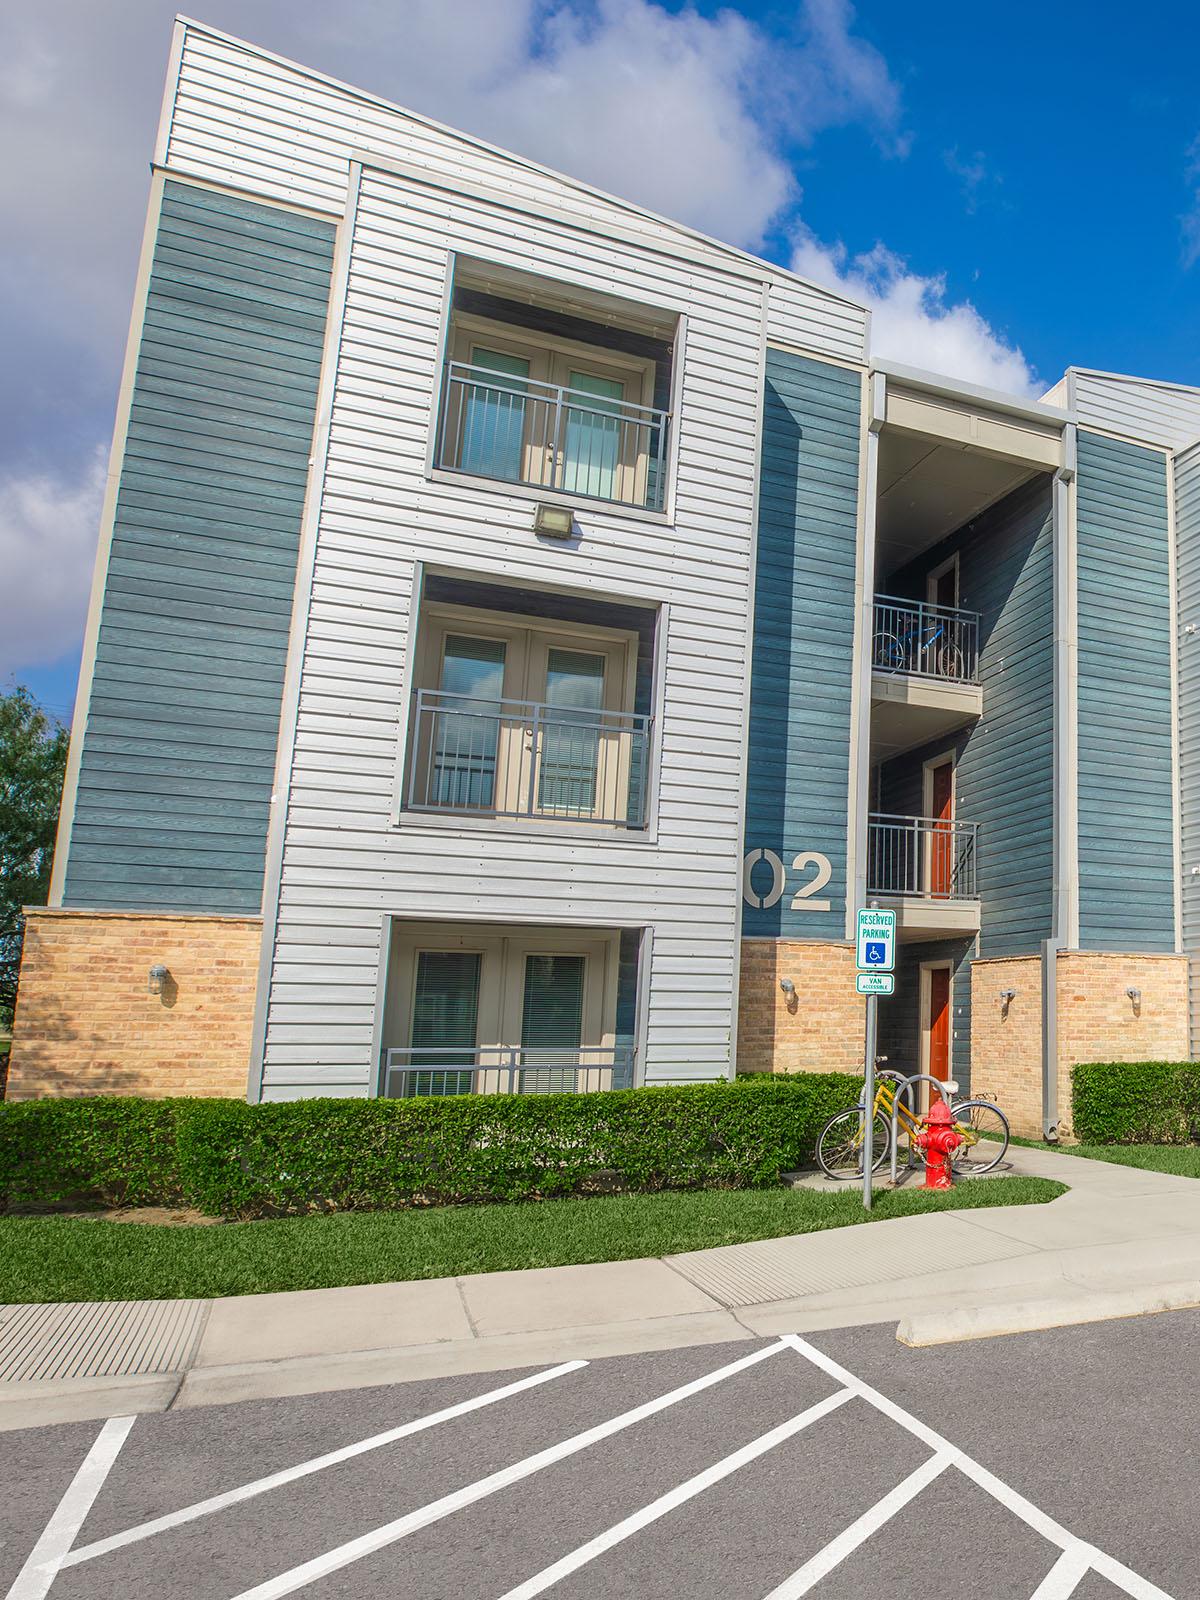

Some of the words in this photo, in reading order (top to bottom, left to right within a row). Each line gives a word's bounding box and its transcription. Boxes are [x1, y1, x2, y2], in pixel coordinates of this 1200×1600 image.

[743, 848, 832, 911] 02
[860, 915, 893, 926] RESERVED
[862, 928, 890, 939] PARKING
